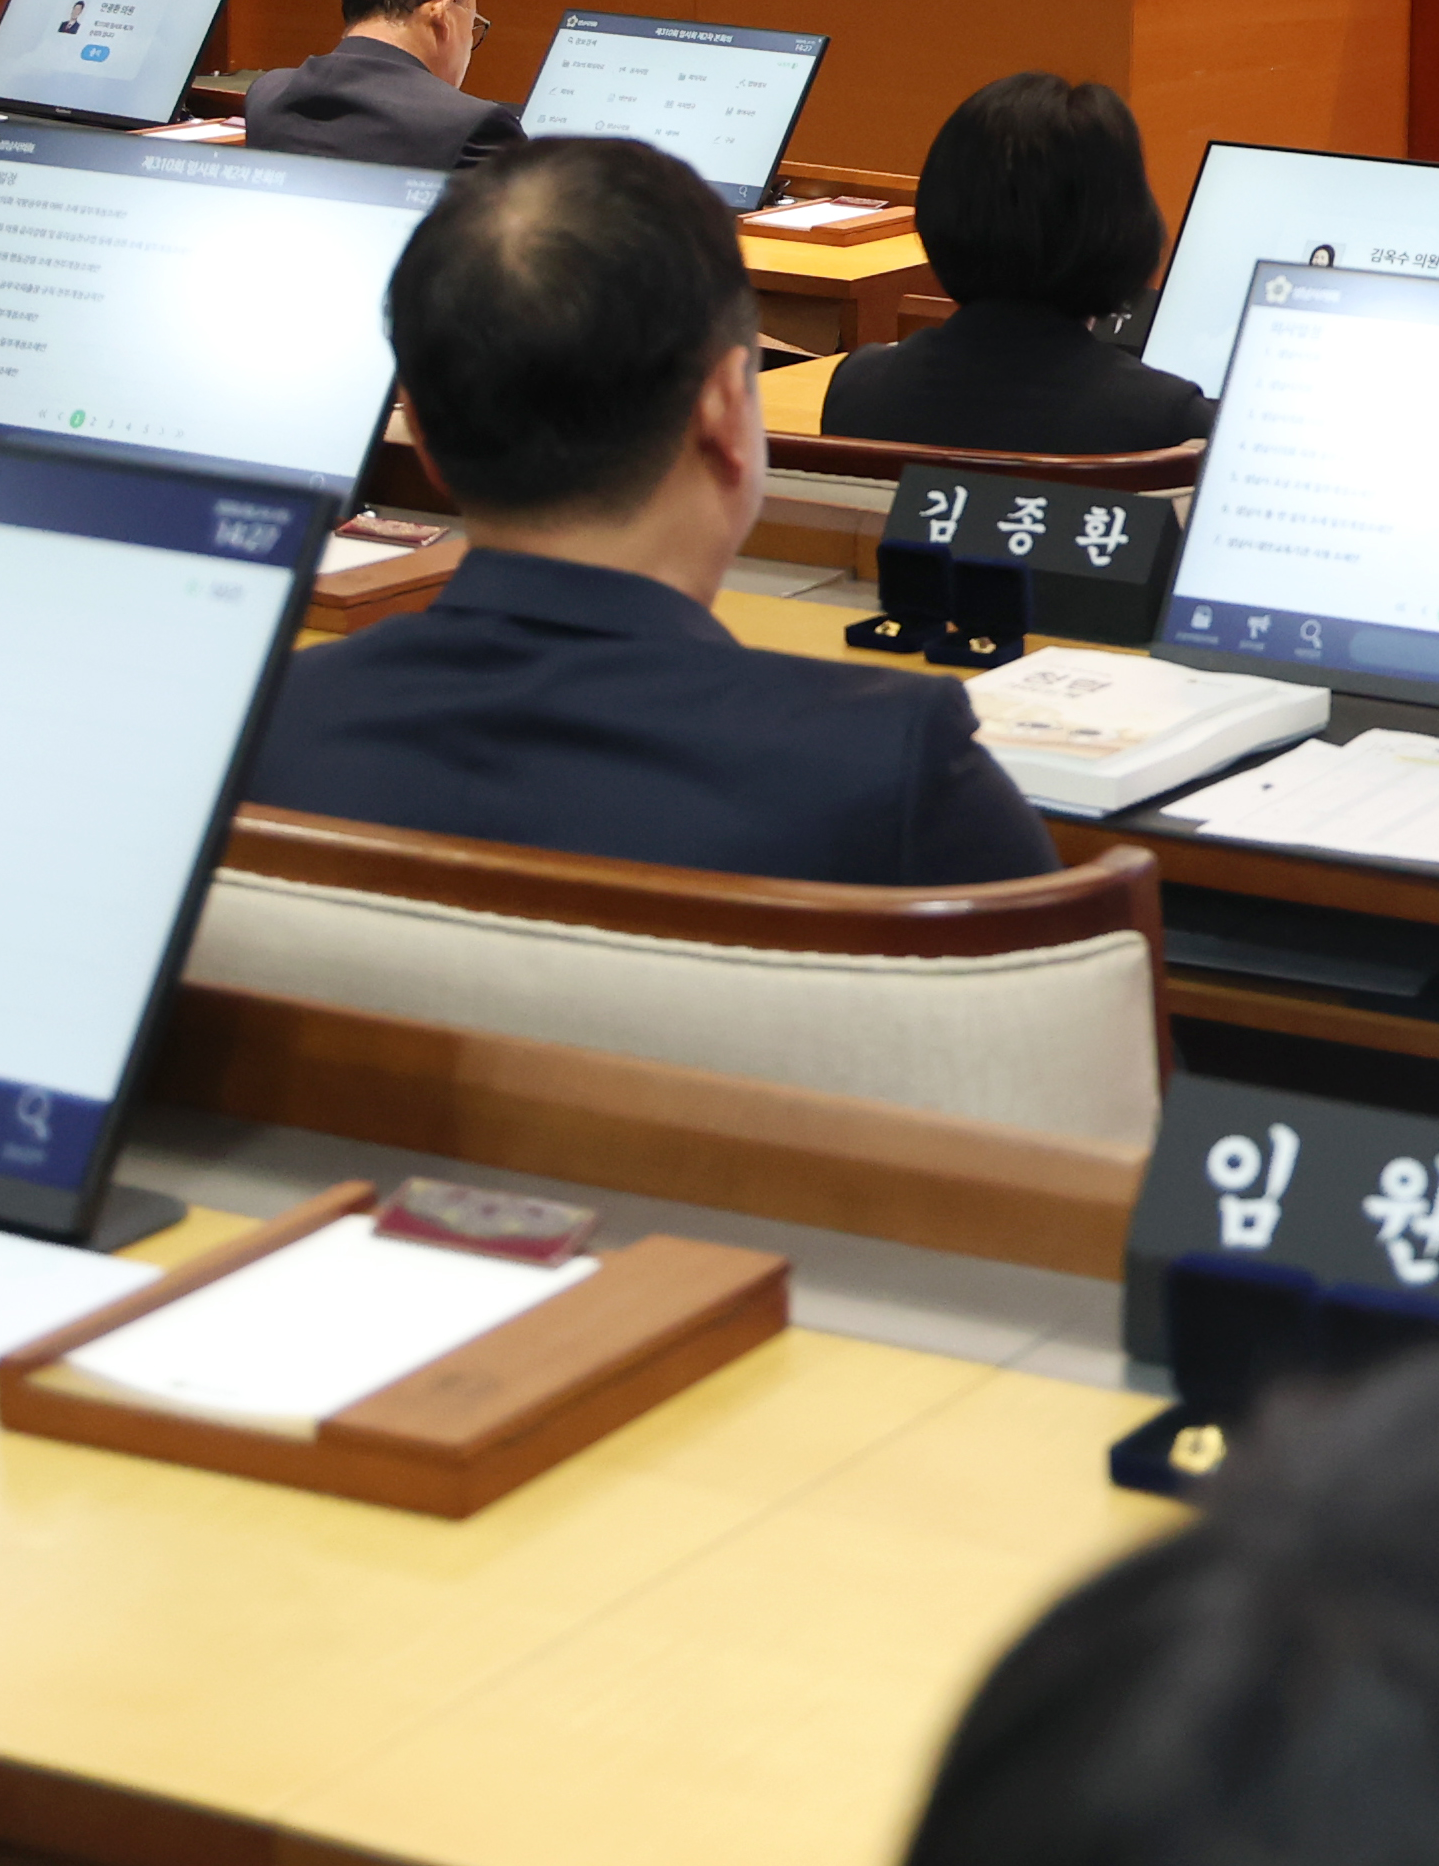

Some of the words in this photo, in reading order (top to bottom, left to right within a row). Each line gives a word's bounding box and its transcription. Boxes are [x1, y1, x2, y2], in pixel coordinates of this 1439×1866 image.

[142, 155, 185, 173] 제310회
[187, 160, 219, 177] 임시회
[221, 164, 250, 181] 제2차
[252, 168, 286, 186] 본회의
[1370, 247, 1410, 266] 김옥수
[919, 485, 1129, 567] 김종환
